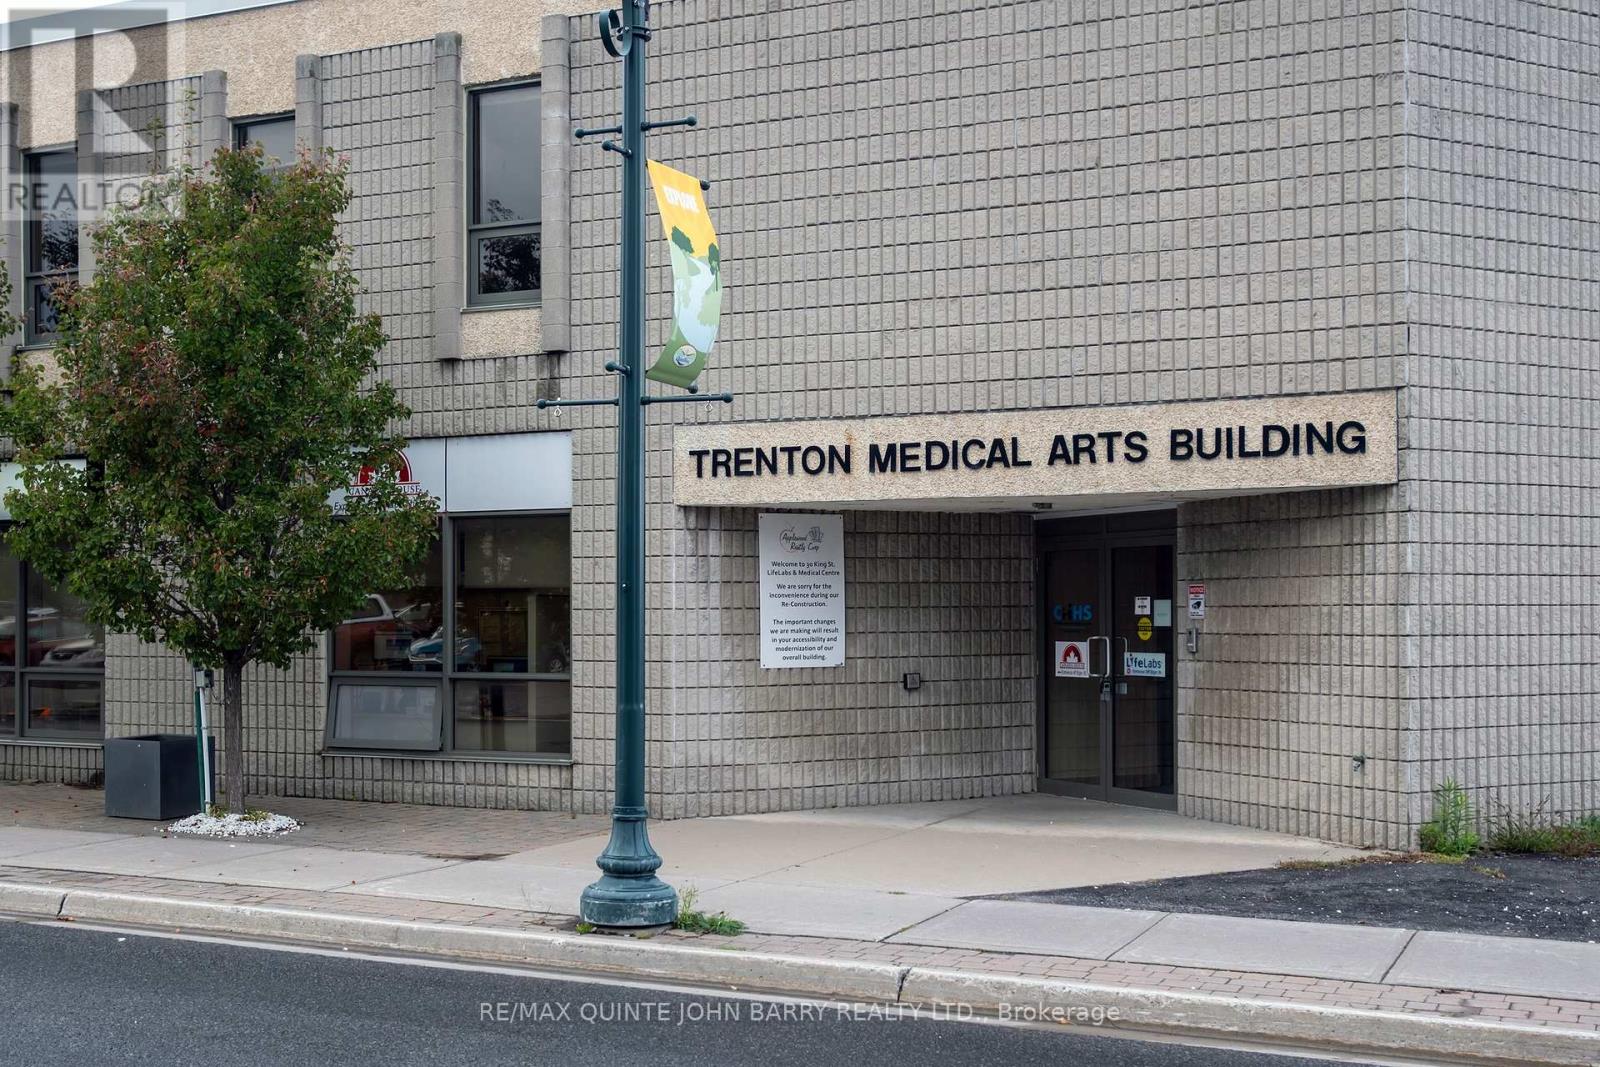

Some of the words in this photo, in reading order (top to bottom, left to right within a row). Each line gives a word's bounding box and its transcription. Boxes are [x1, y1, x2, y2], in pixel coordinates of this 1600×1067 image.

[688, 444, 851, 479] TRENTON
[868, 436, 1032, 474] MEDICAL
[1047, 430, 1149, 467] ARTS
[1169, 420, 1366, 462] BUILDING
[810, 592, 828, 600] during
[784, 618, 812, 626] important
[813, 618, 836, 626] changes
[790, 627, 811, 635] making
[1126, 653, 1162, 669] LifeLabs
